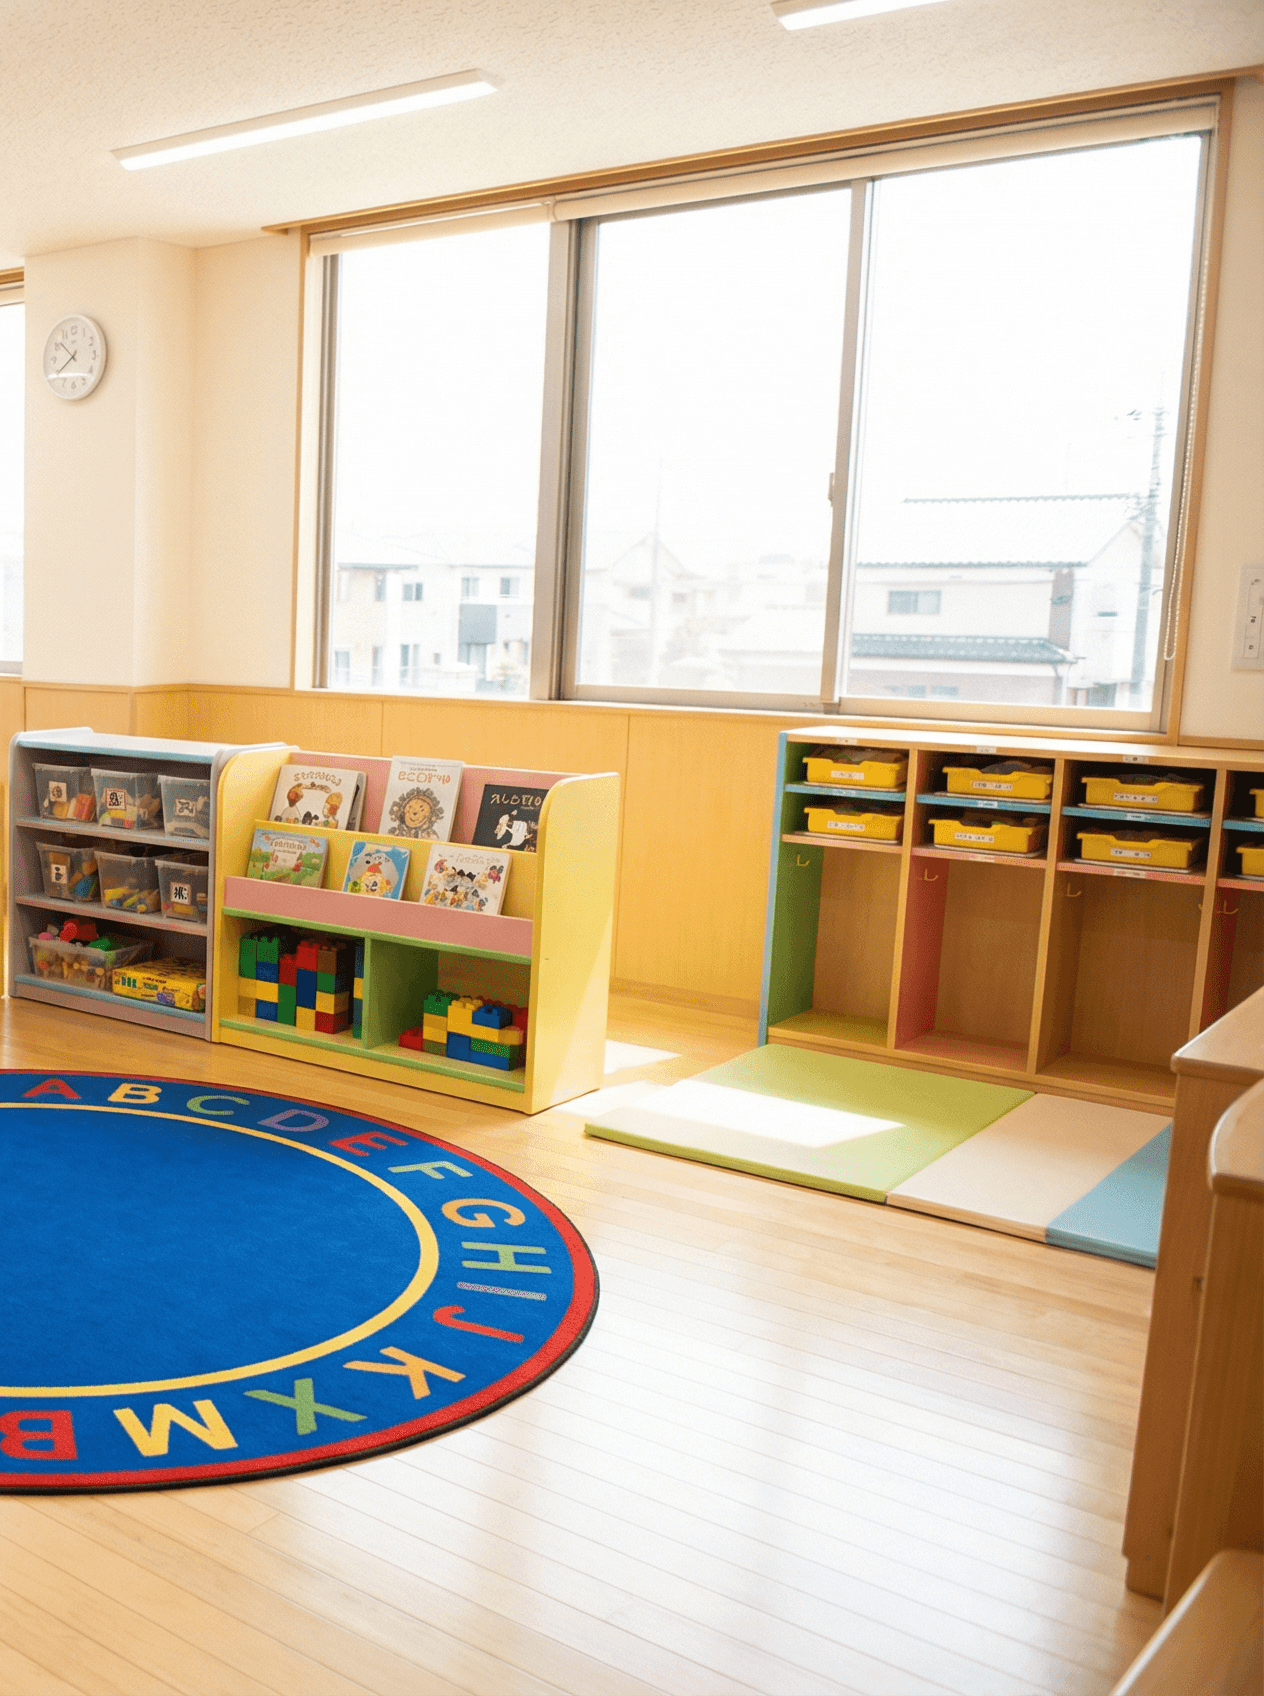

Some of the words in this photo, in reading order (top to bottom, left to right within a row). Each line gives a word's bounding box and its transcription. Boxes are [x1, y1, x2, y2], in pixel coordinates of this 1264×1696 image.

[22, 1078, 82, 1100] A
[107, 1083, 163, 1105] B
[186, 1094, 251, 1116] C
[257, 1108, 330, 1133] D
[328, 1130, 408, 1157] E
[388, 1160, 473, 1180] F
[441, 1198, 526, 1228] G
[461, 1242, 552, 1273] H
[433, 1305, 524, 1343] J
[343, 1346, 466, 1400] K
[244, 1378, 367, 1436] X
